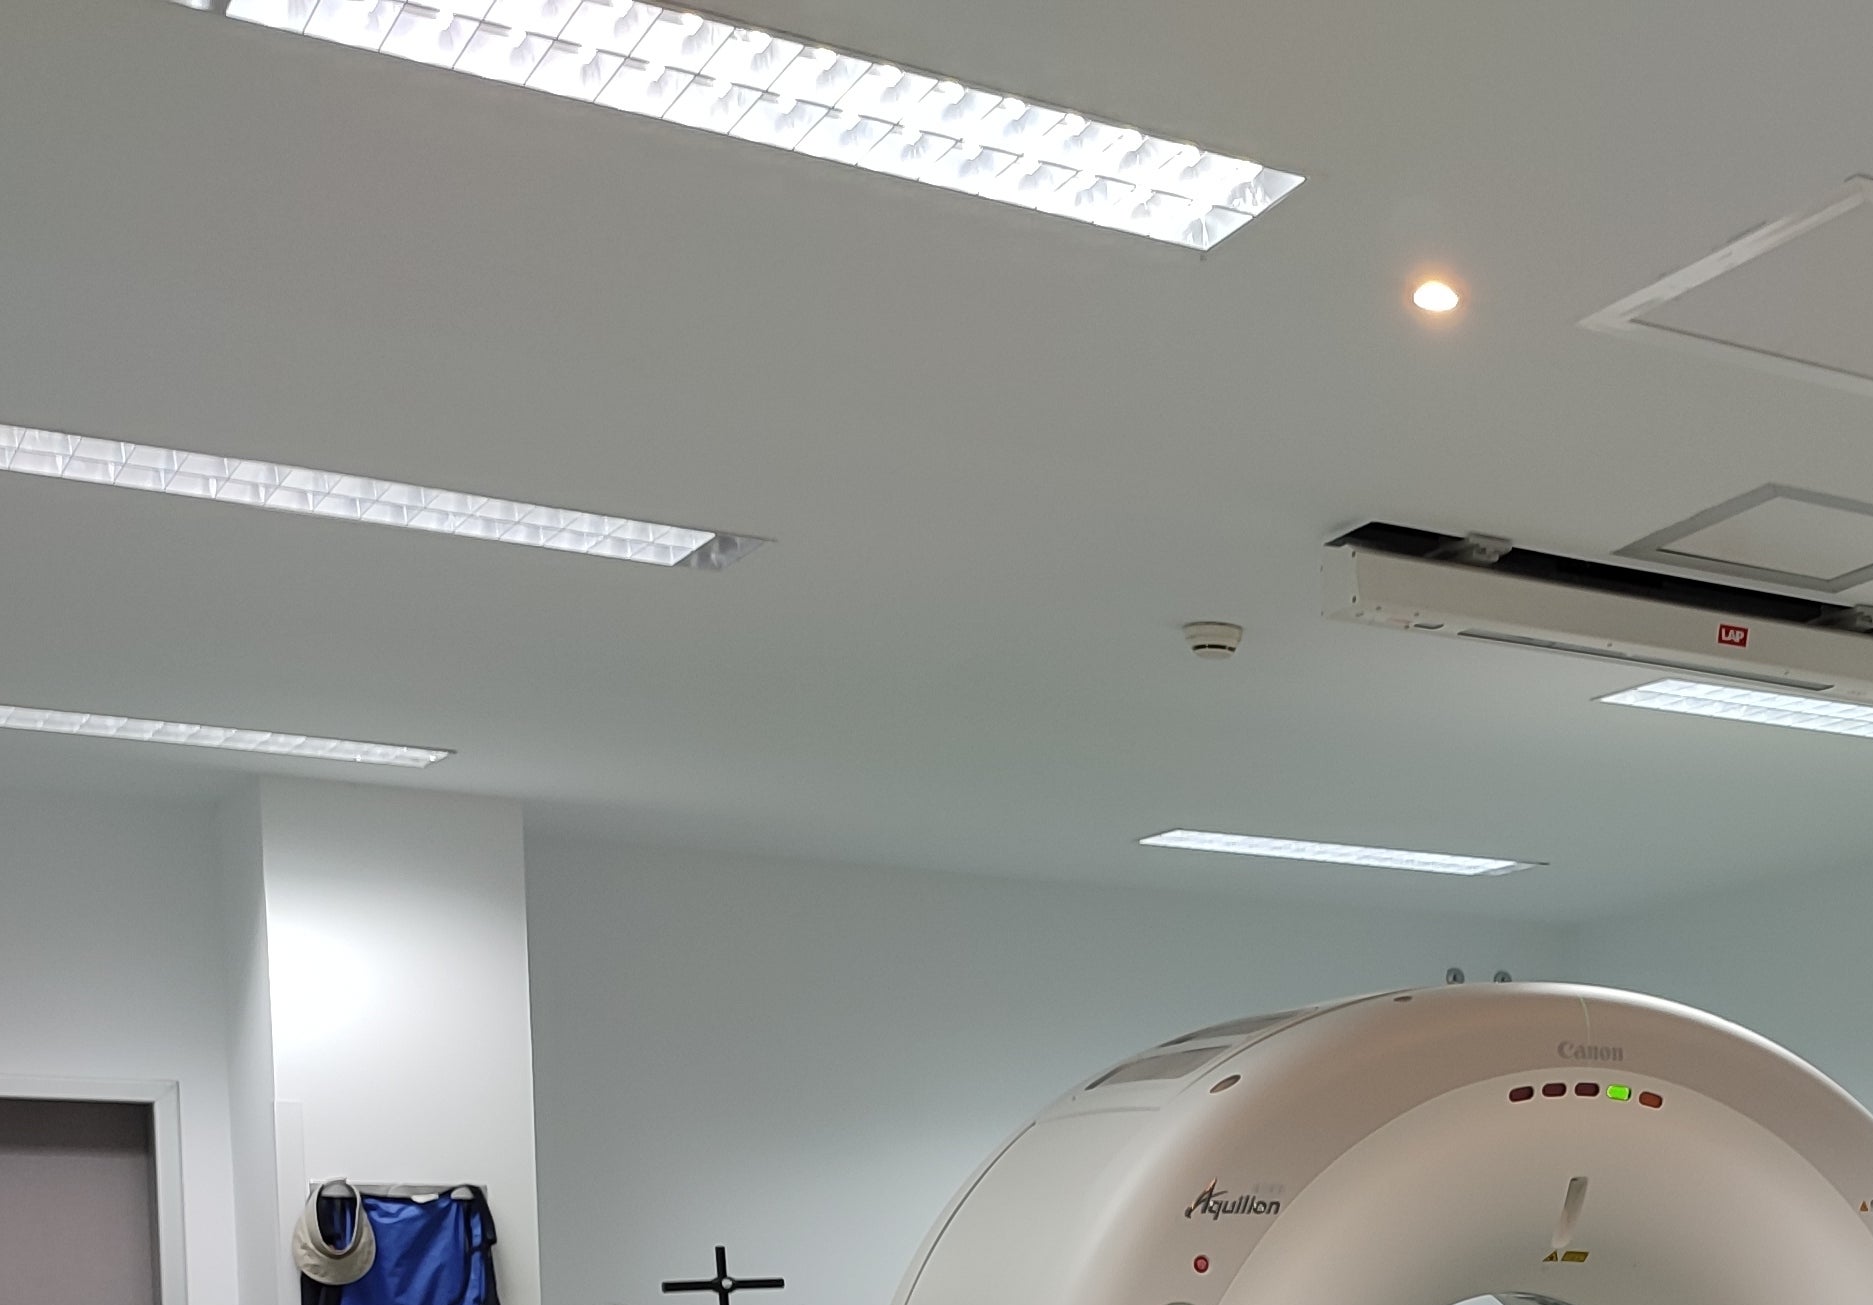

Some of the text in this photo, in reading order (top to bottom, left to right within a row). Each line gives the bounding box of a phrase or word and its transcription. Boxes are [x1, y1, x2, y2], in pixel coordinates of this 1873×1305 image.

[1721, 627, 1745, 643] LAP
[1557, 1041, 1624, 1062] Canon
[1184, 1177, 1281, 1221] Aquilion
